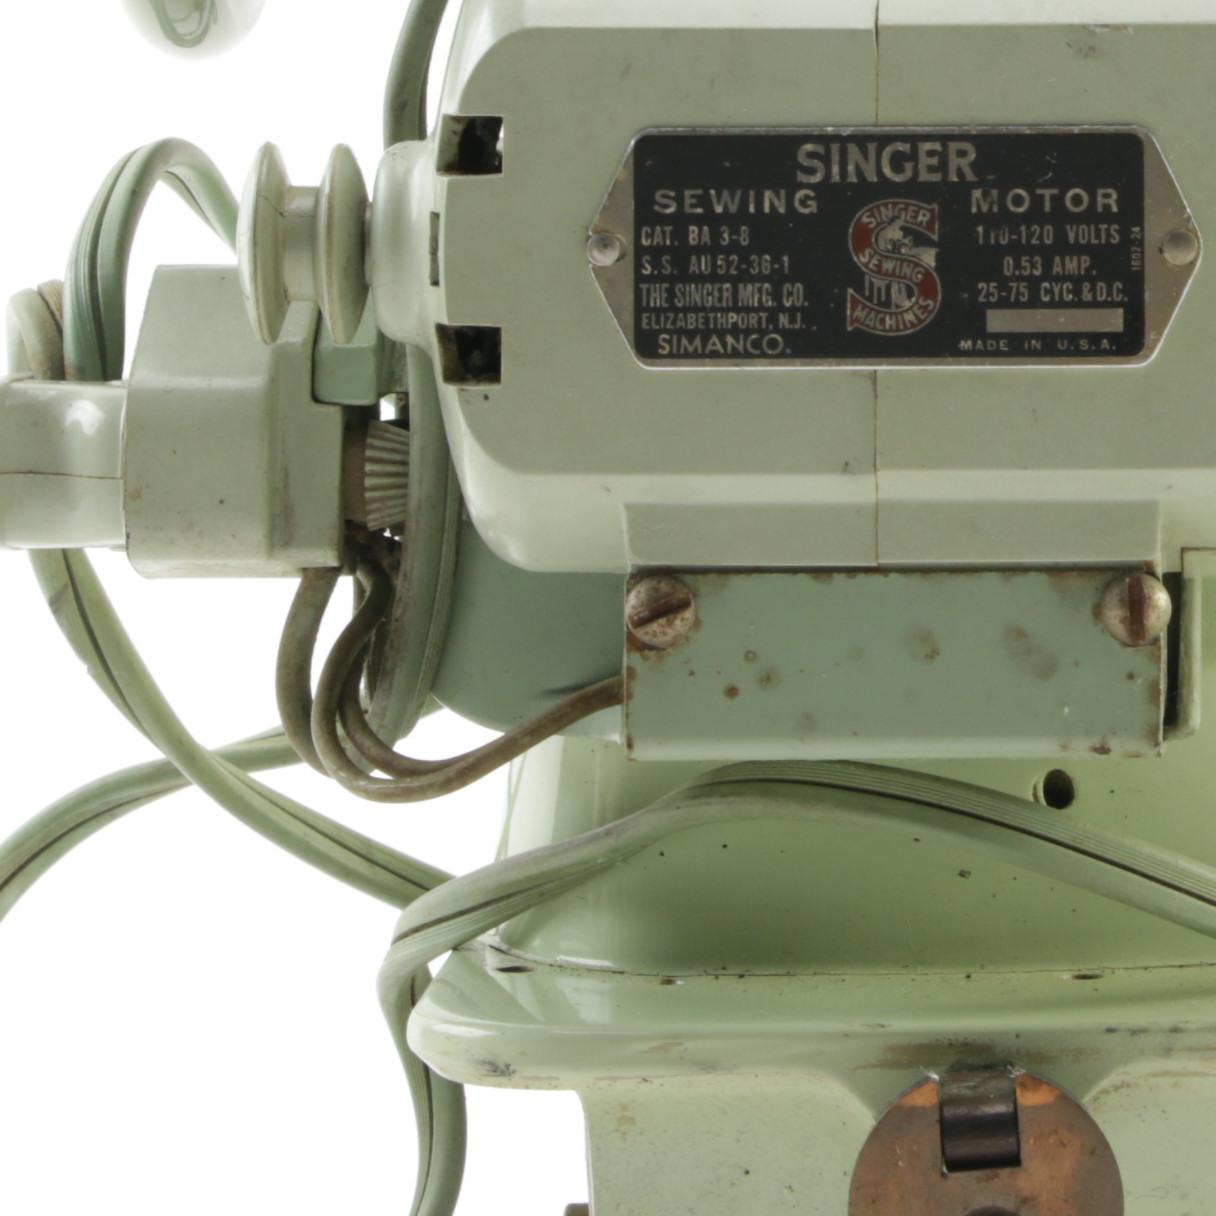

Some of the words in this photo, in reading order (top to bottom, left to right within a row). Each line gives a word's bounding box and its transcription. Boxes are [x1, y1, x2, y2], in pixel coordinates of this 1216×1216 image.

[796, 141, 979, 184] SINGER
[653, 188, 819, 215] SEWING
[971, 187, 1119, 214] MOTOR
[862, 204, 931, 228] SINGER
[641, 226, 679, 246] CAT.
[688, 226, 711, 246] BA
[720, 225, 749, 246] 3-8
[1066, 224, 1120, 245] VOLTS
[641, 255, 678, 275] S.S.
[859, 248, 925, 284] SEWING
[1003, 255, 1043, 276] 0.53
[1052, 255, 1097, 276] AMP.
[640, 283, 669, 307] THE
[674, 283, 733, 307] SINGER
[738, 283, 778, 307] MFG.
[782, 283, 809, 307] CO.
[977, 282, 1029, 303] 25-75
[641, 312, 774, 331] ELIZABETHPORT,
[778, 312, 806, 330] N.J.
[852, 297, 936, 331] MACHINES
[657, 334, 792, 355] SIMANCO.
[959, 339, 1009, 351] MADE
[1025, 339, 1042, 351] IN
[1057, 339, 1117, 351] U.S.A.
